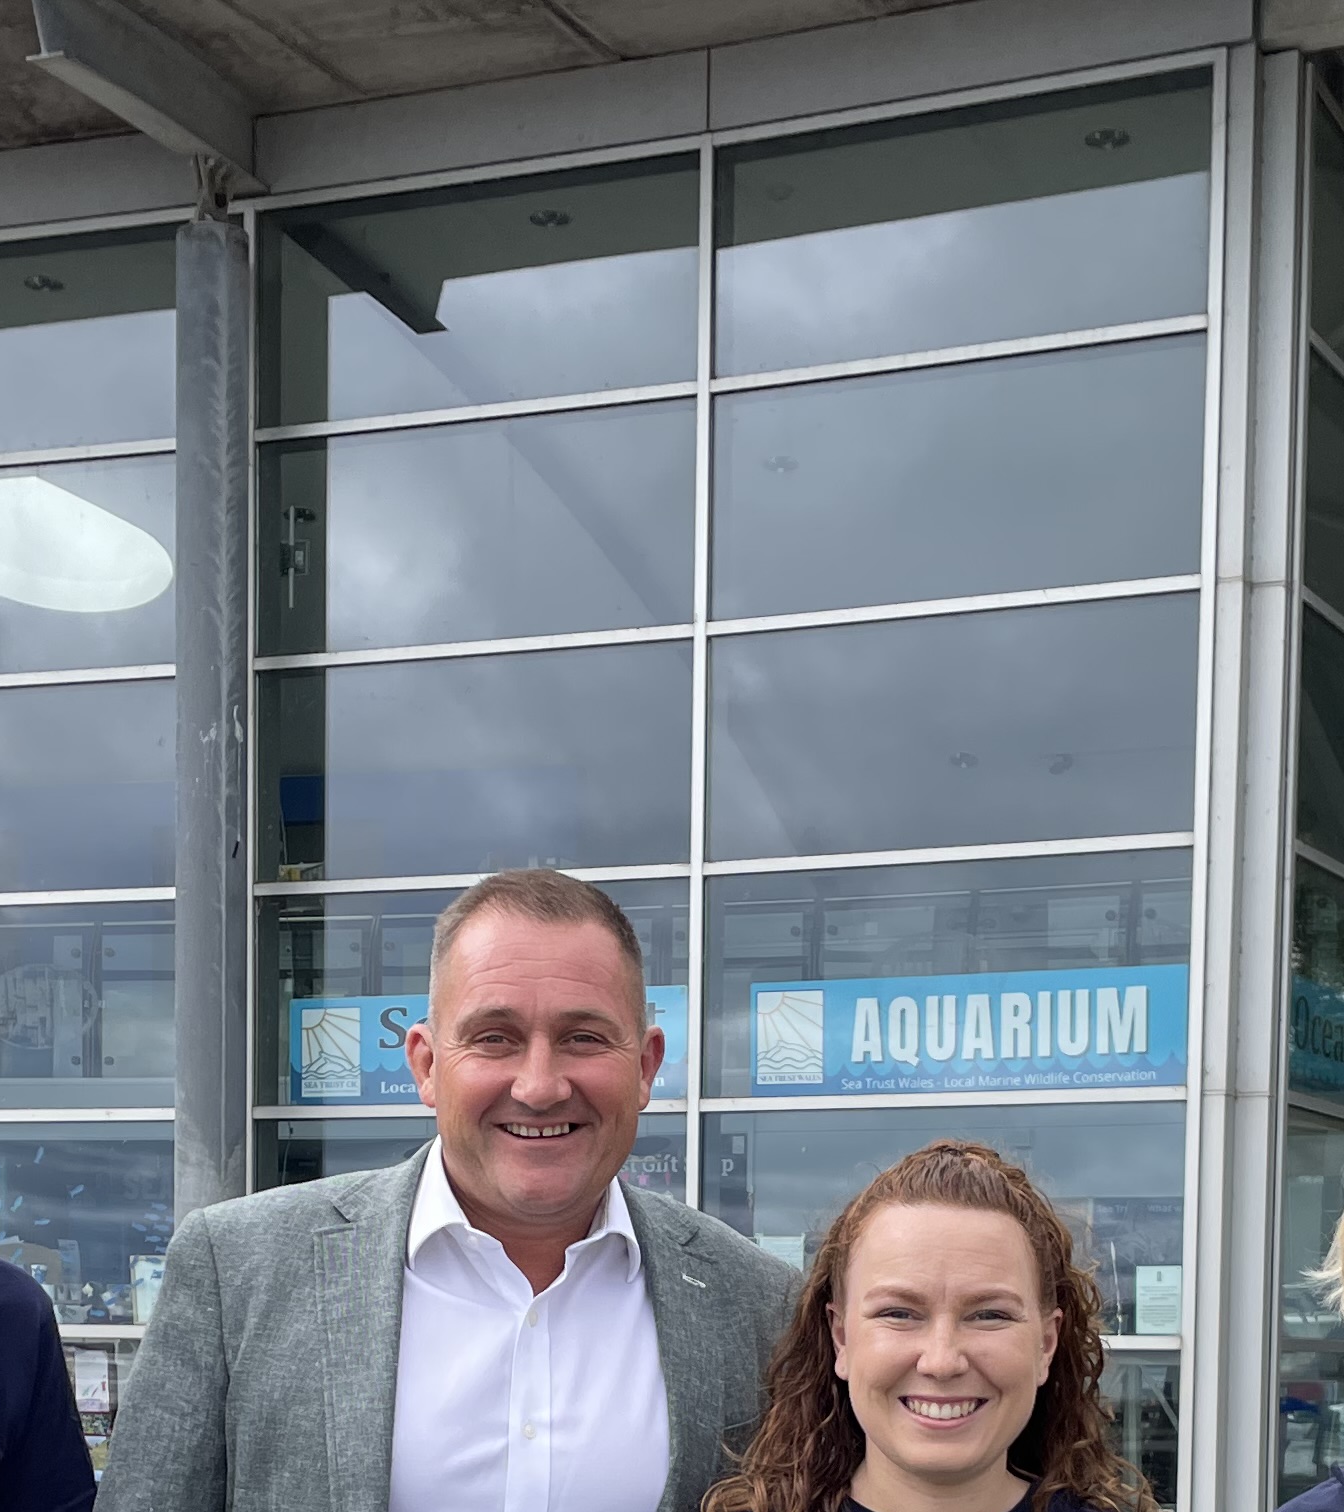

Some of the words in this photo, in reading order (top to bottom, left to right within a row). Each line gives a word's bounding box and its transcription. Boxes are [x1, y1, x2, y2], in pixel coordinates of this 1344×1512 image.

[850, 985, 1148, 1067] AQUARIUM
[304, 1081, 318, 1089] SEA
[319, 1081, 345, 1089] TRUST
[841, 1078, 862, 1090] Sea
[866, 1077, 895, 1090] Trust
[898, 1076, 934, 1089] Wales
[944, 1075, 975, 1088] Local
[978, 1074, 1022, 1087] Marine
[1024, 1072, 1070, 1086] Wildlife
[1073, 1069, 1157, 1084] Conservation
[642, 1154, 679, 1173] Gift
